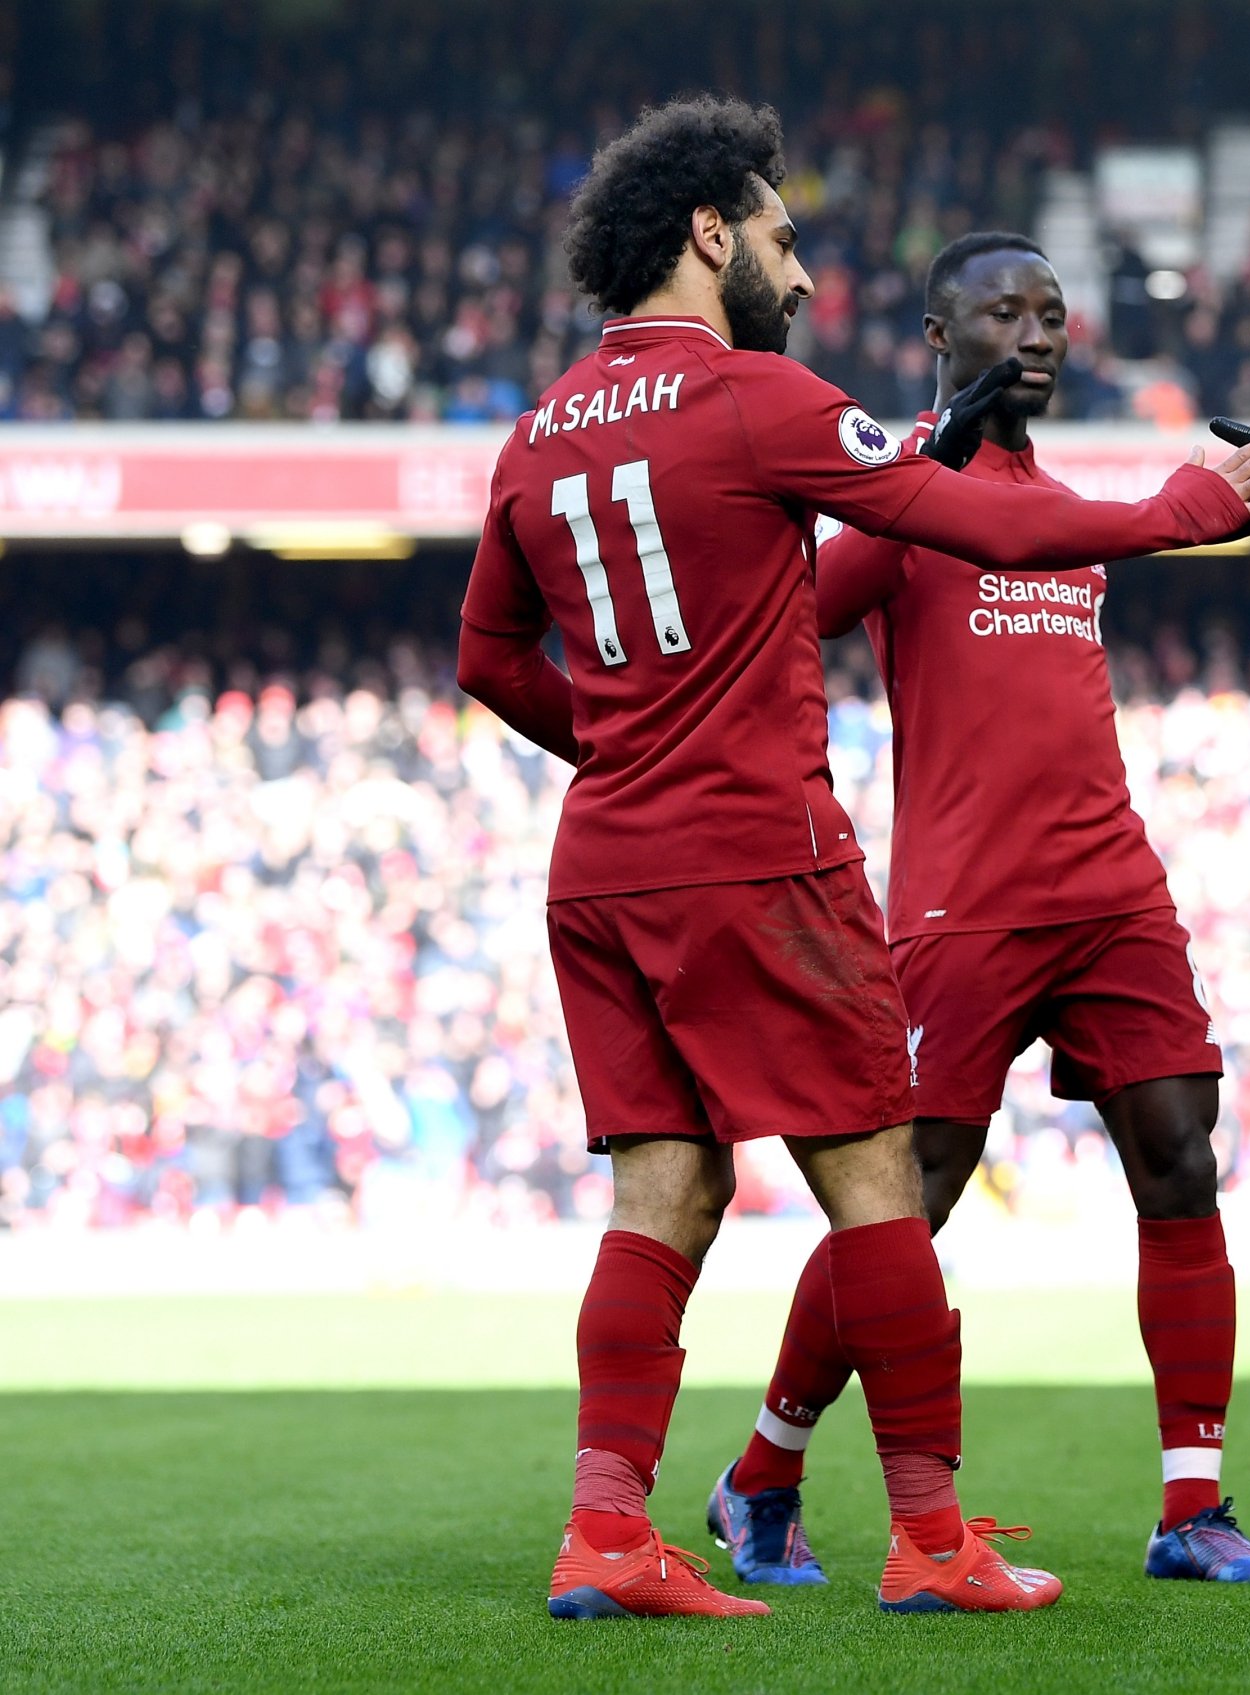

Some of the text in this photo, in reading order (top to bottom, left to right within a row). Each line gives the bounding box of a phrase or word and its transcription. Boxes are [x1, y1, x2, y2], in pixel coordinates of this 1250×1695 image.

[528, 373, 685, 445] M.SALAH
[552, 459, 692, 667] 11
[978, 574, 1092, 610] Standard
[968, 608, 1094, 642] Chartered
